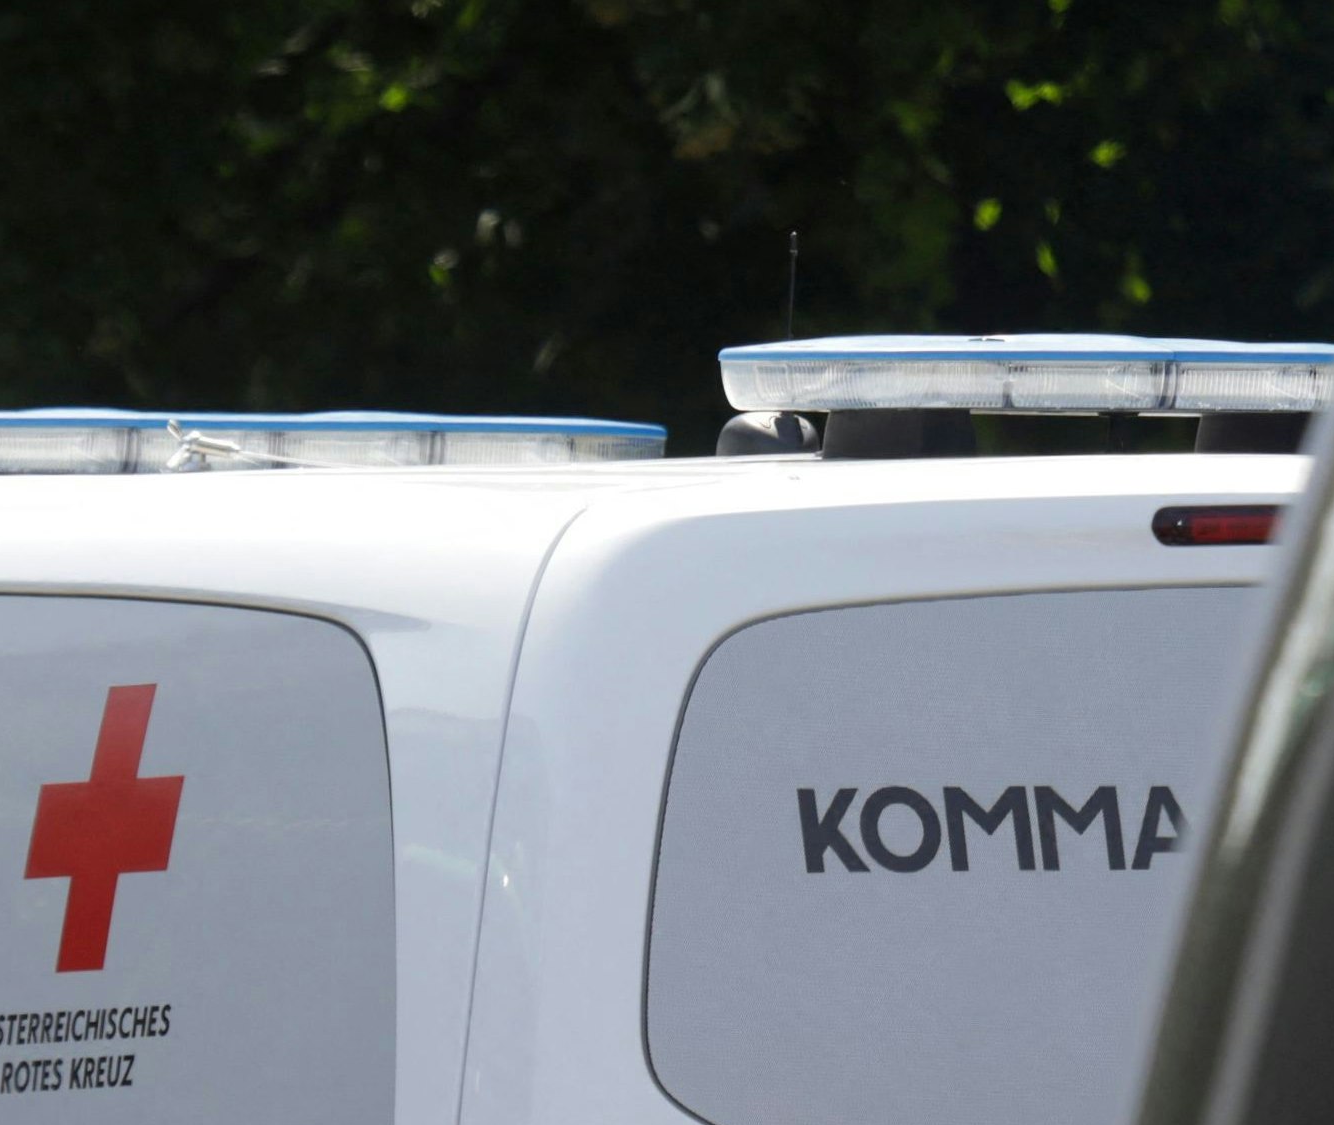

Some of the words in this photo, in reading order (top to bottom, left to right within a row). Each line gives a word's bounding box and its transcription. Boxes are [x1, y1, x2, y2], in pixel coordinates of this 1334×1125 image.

[797, 785, 1189, 873] KOMMA
[0, 1059, 64, 1095] ROTES
[69, 1054, 136, 1090] KREUZ
